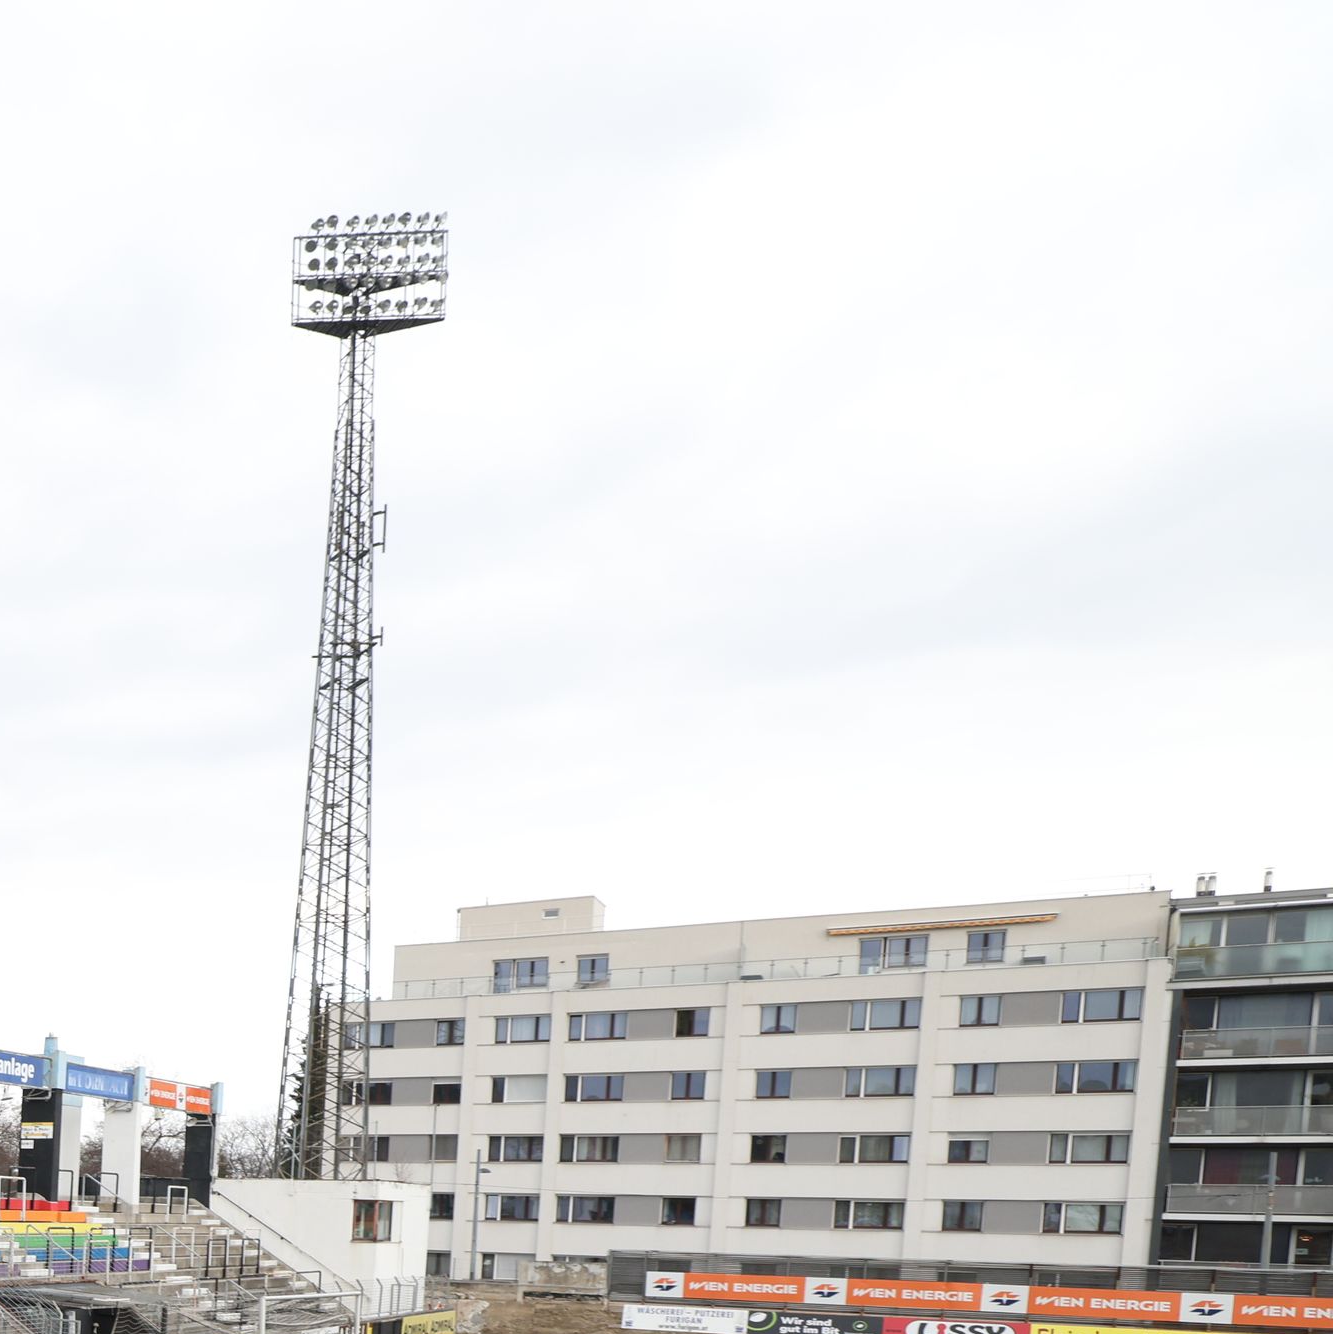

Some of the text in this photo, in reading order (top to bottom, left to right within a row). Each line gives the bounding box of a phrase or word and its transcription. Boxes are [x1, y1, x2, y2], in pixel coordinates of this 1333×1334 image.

[689, 1281, 798, 1295] WIEN ENERGIE
[853, 1288, 974, 1302] WIEN ENERGIE
[1035, 1295, 1172, 1313] WIEN ENERGIE
[1241, 1304, 1297, 1319] WIEN
[780, 1316, 833, 1328] Wir sind
[803, 1326, 818, 1334] im
